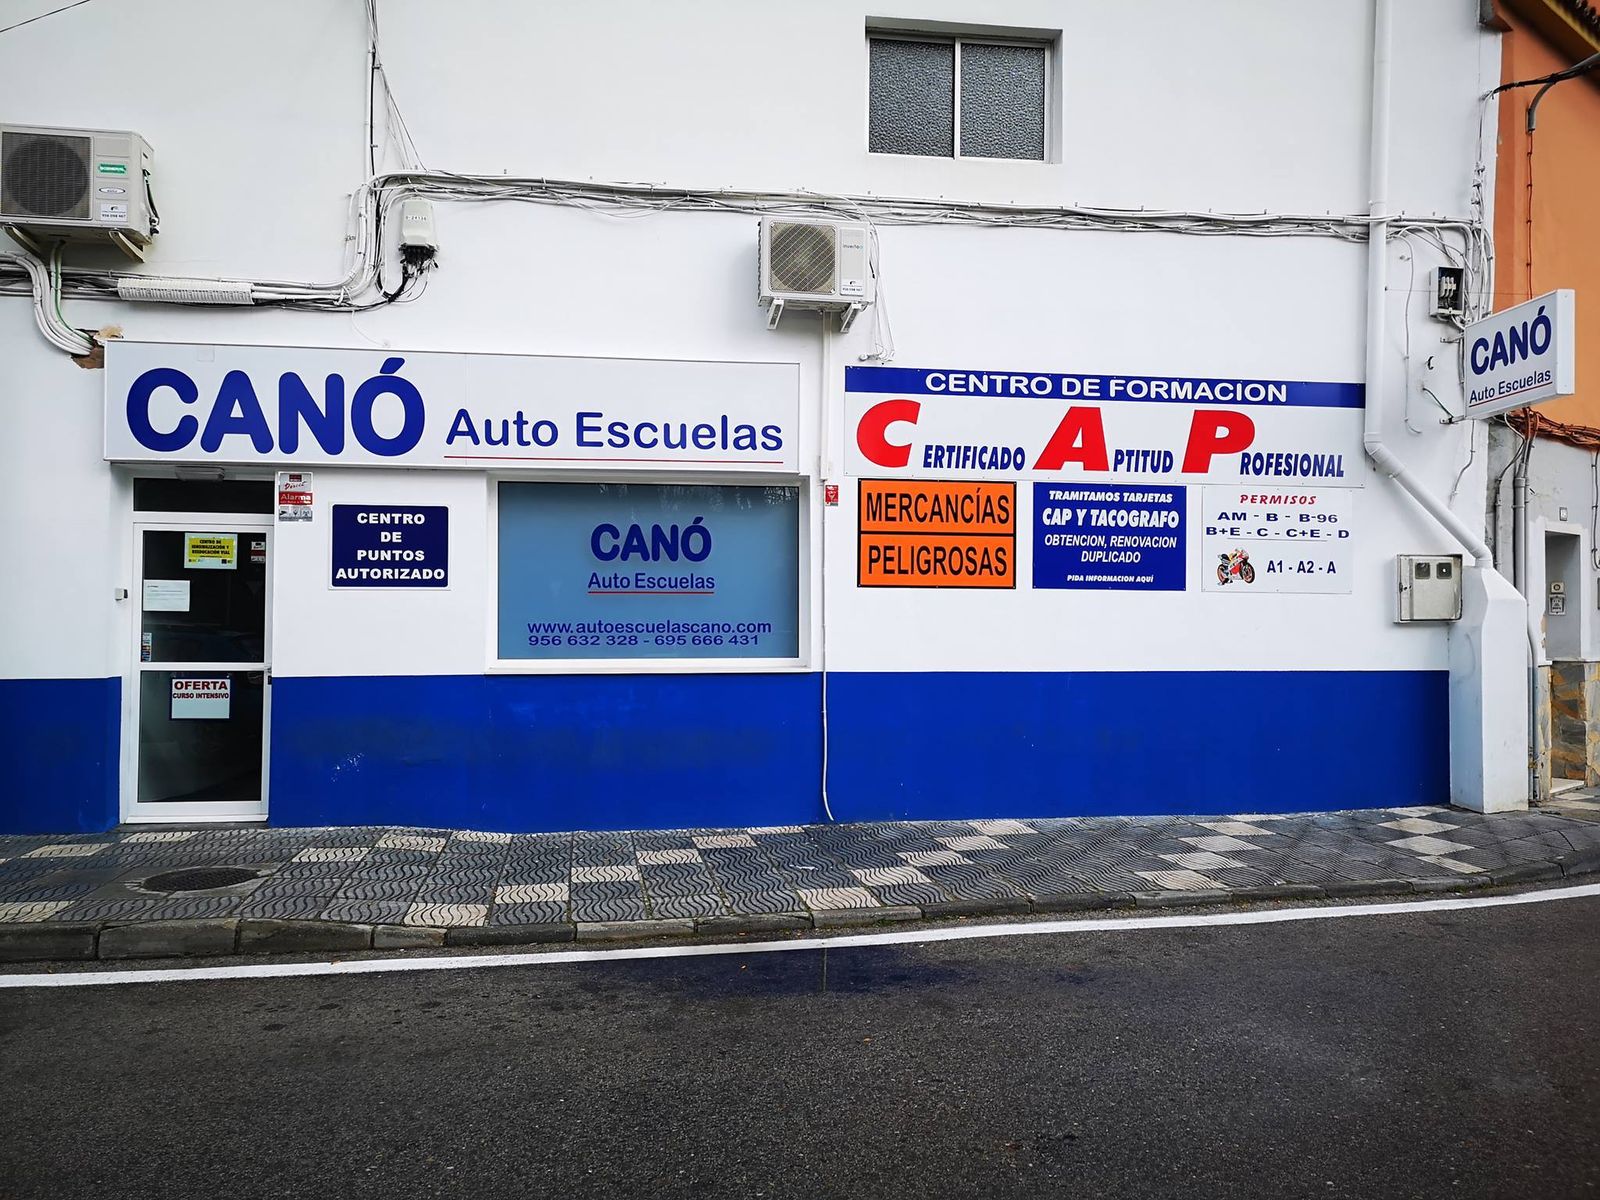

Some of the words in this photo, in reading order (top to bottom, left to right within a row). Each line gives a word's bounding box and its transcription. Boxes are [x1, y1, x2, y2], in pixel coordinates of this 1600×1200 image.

[1470, 305, 1552, 376] CANÓ
[925, 372, 1053, 396] CENTRO
[1061, 377, 1101, 397] DE
[1109, 379, 1287, 403] FORMACION
[1469, 386, 1496, 404] Auto
[1498, 370, 1551, 395] Escuelas
[126, 357, 425, 457] CANÓ
[446, 408, 558, 447] Auto
[576, 412, 784, 452] Escuelas
[1048, 490, 1120, 502] TRAMITAMOS
[1122, 492, 1173, 503] TARJETAS
[1240, 494, 1317, 505] PERMISOS
[866, 487, 1010, 525] MERCANCÍAS
[356, 512, 426, 524] CENTRO
[1042, 508, 1072, 526] CAP
[1076, 508, 1088, 526] Y
[1090, 509, 1180, 528] TACOGRAFO
[1217, 512, 1247, 521] AM
[1266, 513, 1278, 522] B
[1298, 514, 1338, 524] B-96
[380, 532, 402, 542] DE
[1206, 526, 1241, 536] B+E
[1256, 528, 1268, 537] C
[1286, 528, 1321, 538] C+E
[1338, 530, 1350, 538] D
[590, 516, 712, 562] CANÓ
[1044, 534, 1107, 548] OBTENCION,
[1110, 536, 1177, 548] RENOVACION
[356, 550, 425, 562] PUNTOS
[868, 544, 1007, 576] PELIGROSAS
[1081, 550, 1141, 563] DUPLICADO
[1266, 560, 1283, 574] A1
[1296, 560, 1314, 574] A2
[1326, 561, 1336, 574] A
[336, 568, 446, 580] AUTORIZADO
[1086, 574, 1135, 582] INFORMACION
[1136, 574, 1154, 584] AQUÍ
[588, 572, 630, 589] Auto
[634, 572, 715, 590] Escuelas
[528, 620, 772, 634] www.autoescuelascano.com
[528, 635, 562, 646] 956
[567, 635, 600, 646] 632
[606, 635, 638, 646] 328
[654, 635, 687, 646] 695
[692, 635, 724, 646] 666
[728, 635, 759, 646] 431
[174, 680, 228, 690] OFERTA
